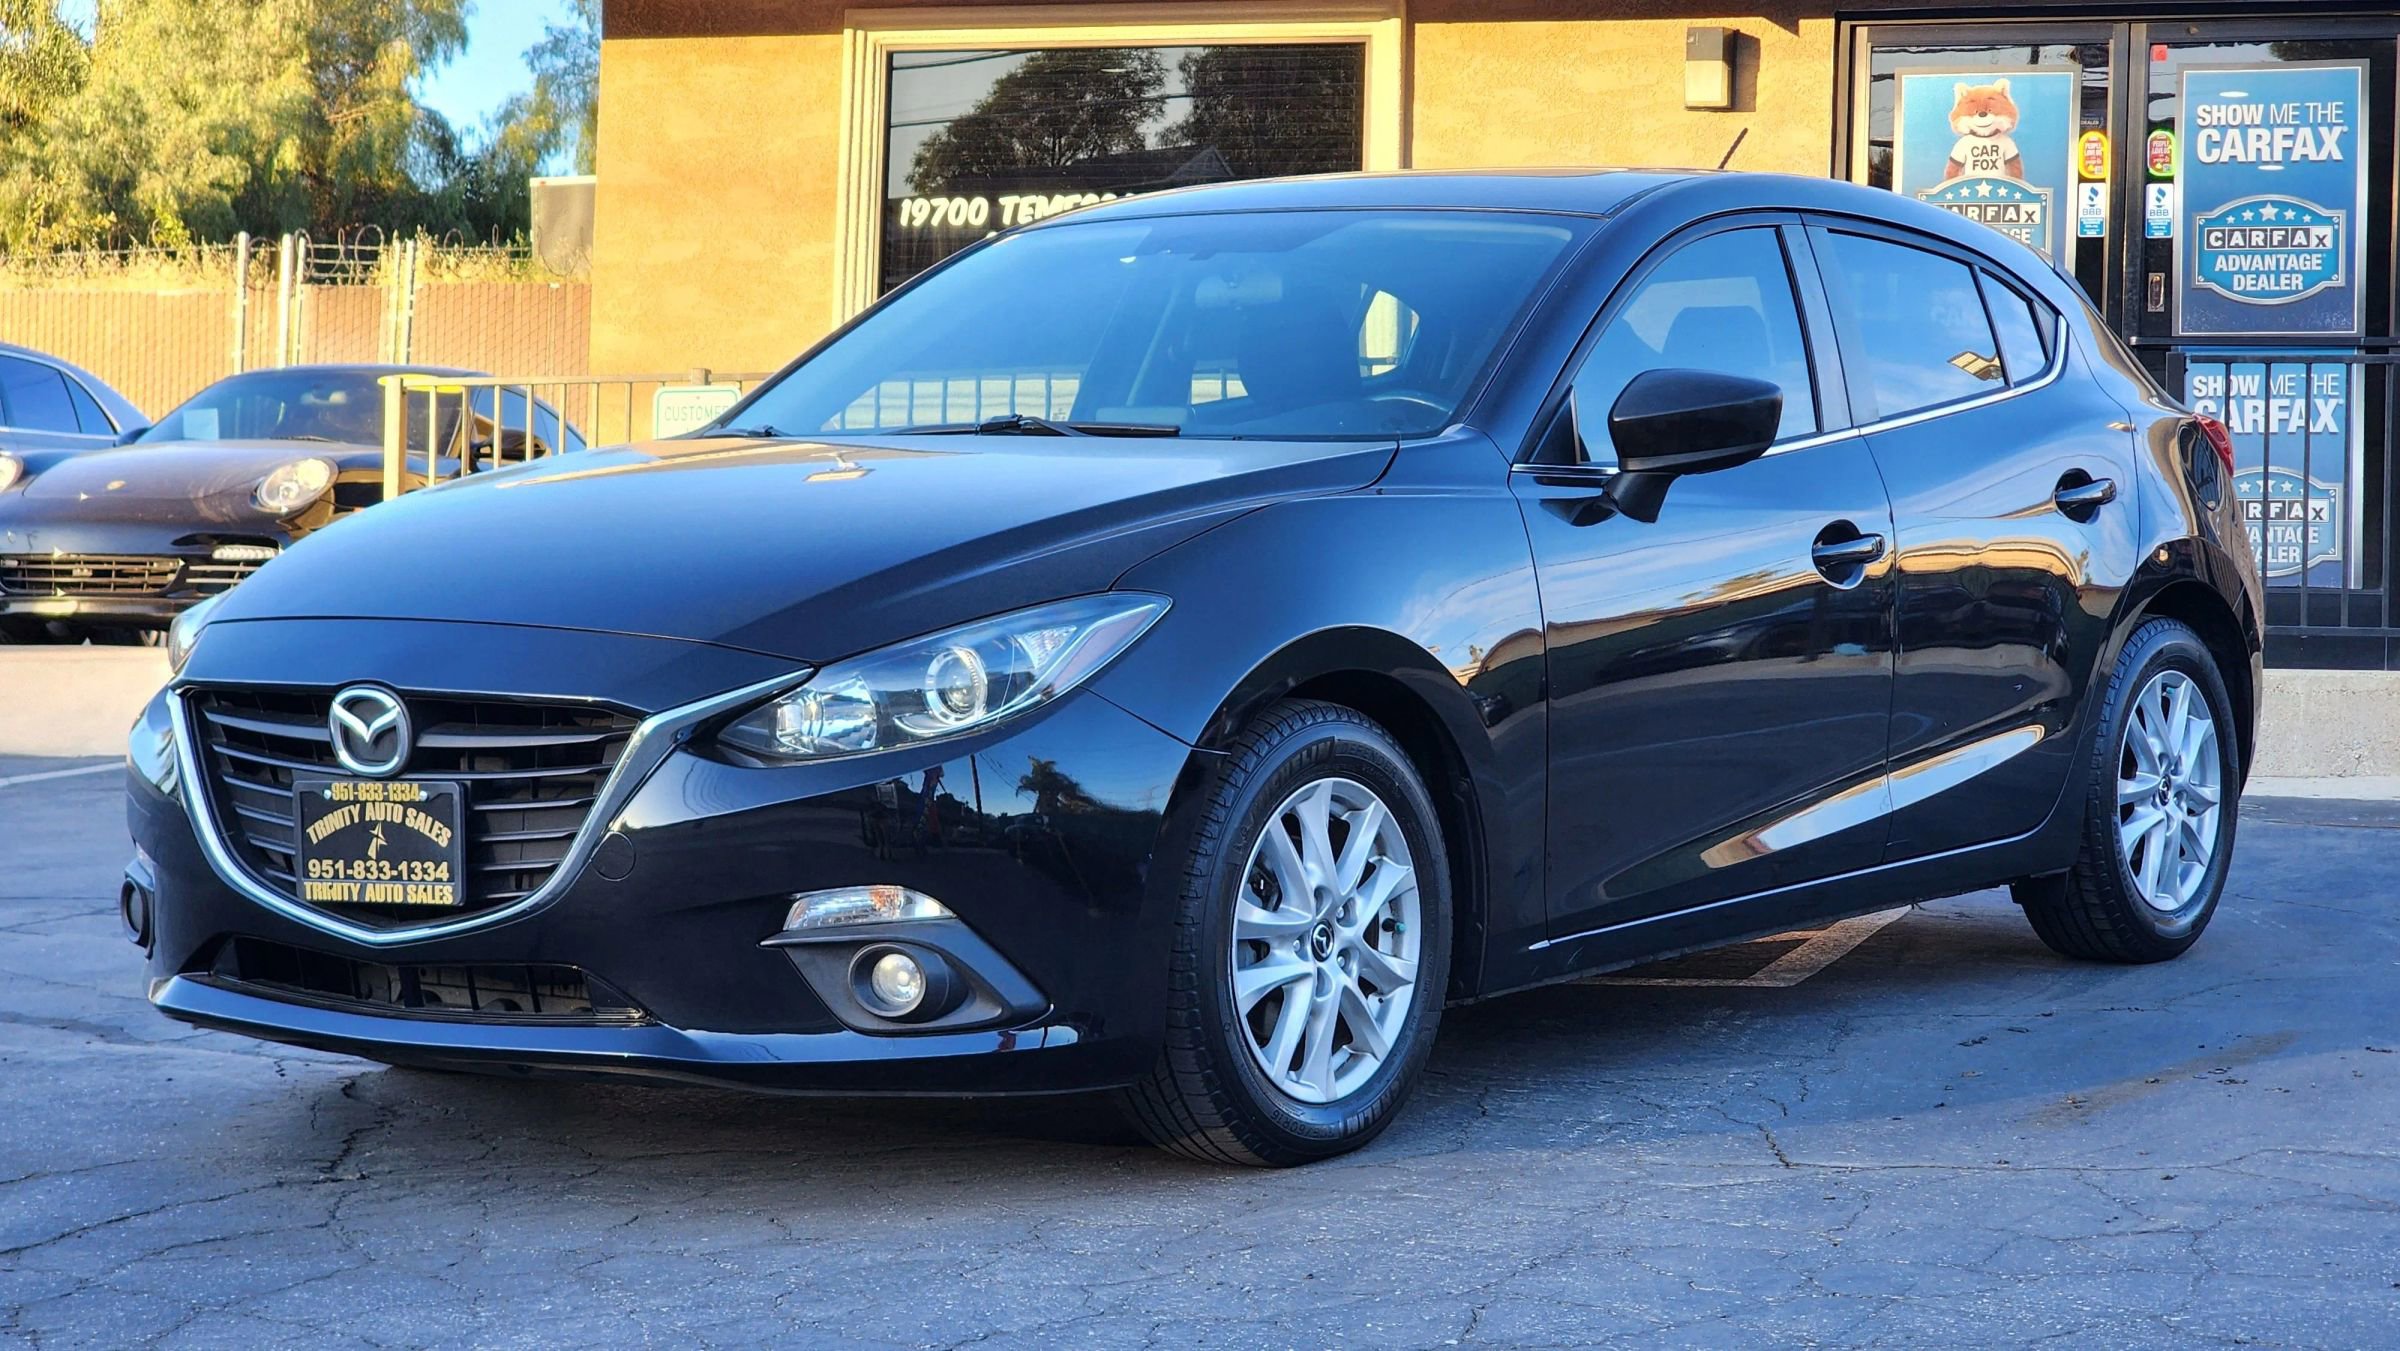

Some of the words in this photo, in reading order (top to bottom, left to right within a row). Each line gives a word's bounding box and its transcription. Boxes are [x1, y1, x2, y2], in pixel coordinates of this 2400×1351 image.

[2197, 104, 2264, 126] SHOW
[2270, 103, 2300, 125] ME
[2305, 102, 2344, 124] THE
[1971, 144, 2000, 158] CAR
[2197, 126, 2344, 163] CARFAX
[1972, 159, 1999, 171] FOX
[900, 196, 989, 227] 19700
[1951, 206, 2036, 223] RFAX
[2082, 208, 2102, 216] BBB
[2209, 231, 2328, 247] CARFAX
[2215, 254, 2322, 272] ADVANTAGE
[2233, 274, 2303, 291] DEALER
[2192, 375, 2260, 397] SHOW
[2270, 374, 2297, 396] ME
[2248, 502, 2325, 521] RFAX
[2254, 546, 2301, 563] ALER
[331, 783, 420, 802] 951-833-1334
[306, 803, 361, 845] TRINITY
[365, 802, 404, 823] AUTO
[405, 807, 452, 848] SALES
[308, 859, 449, 882] 951-833-1334
[304, 882, 361, 902] TRINITY
[365, 883, 404, 903] AUTO
[406, 884, 453, 905] SALES
